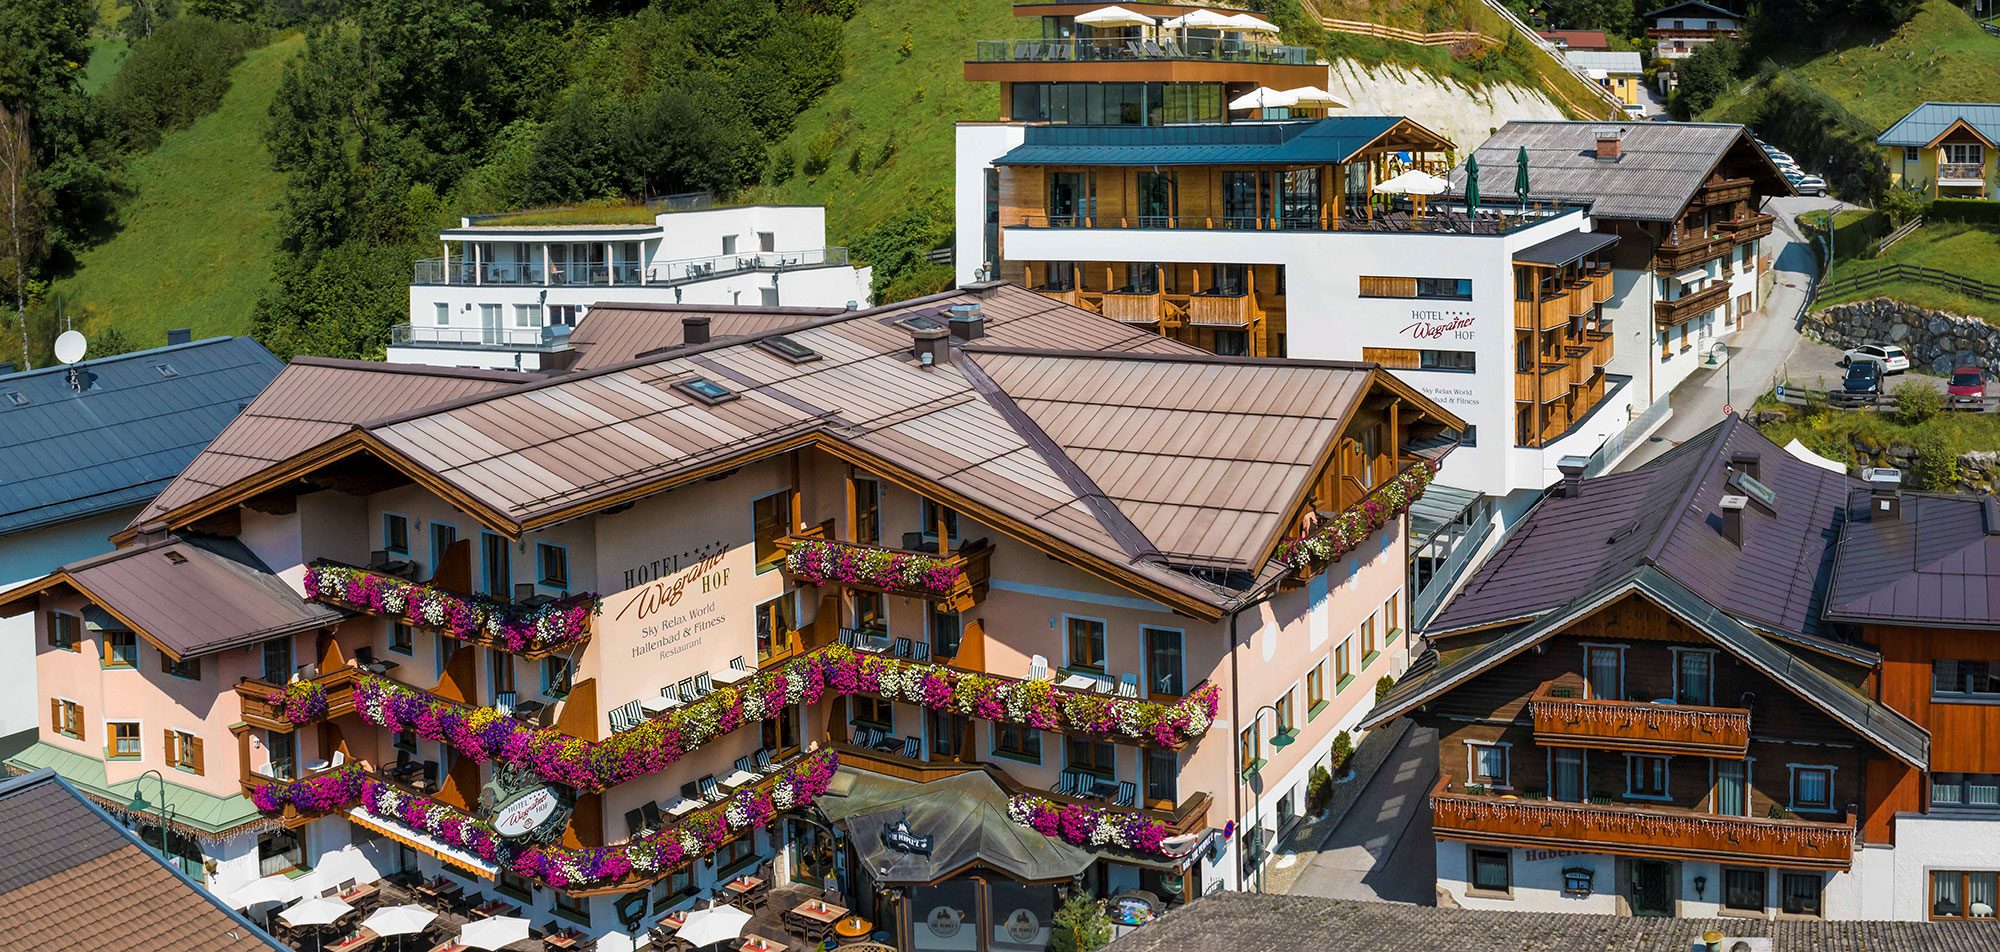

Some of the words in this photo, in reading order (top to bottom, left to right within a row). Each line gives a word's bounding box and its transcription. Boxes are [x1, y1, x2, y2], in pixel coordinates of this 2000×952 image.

[1411, 310, 1444, 321] HOTEL
[1399, 316, 1475, 339] Wagrainer
[1454, 330, 1475, 340] HOF
[1421, 387, 1433, 395] Sky
[615, 543, 730, 622] Wagrainer
[624, 554, 682, 591] HOTEL
[701, 567, 731, 594] HOF
[641, 626, 659, 640] Sky
[661, 615, 687, 631] Relax
[689, 601, 716, 621] World
[632, 631, 681, 659] Hallenbad
[682, 627, 692, 639] &
[693, 613, 726, 635] Fitness
[659, 637, 702, 660] Restaurant
[508, 800, 528, 813] HOTEL
[536, 802, 549, 813] HOF
